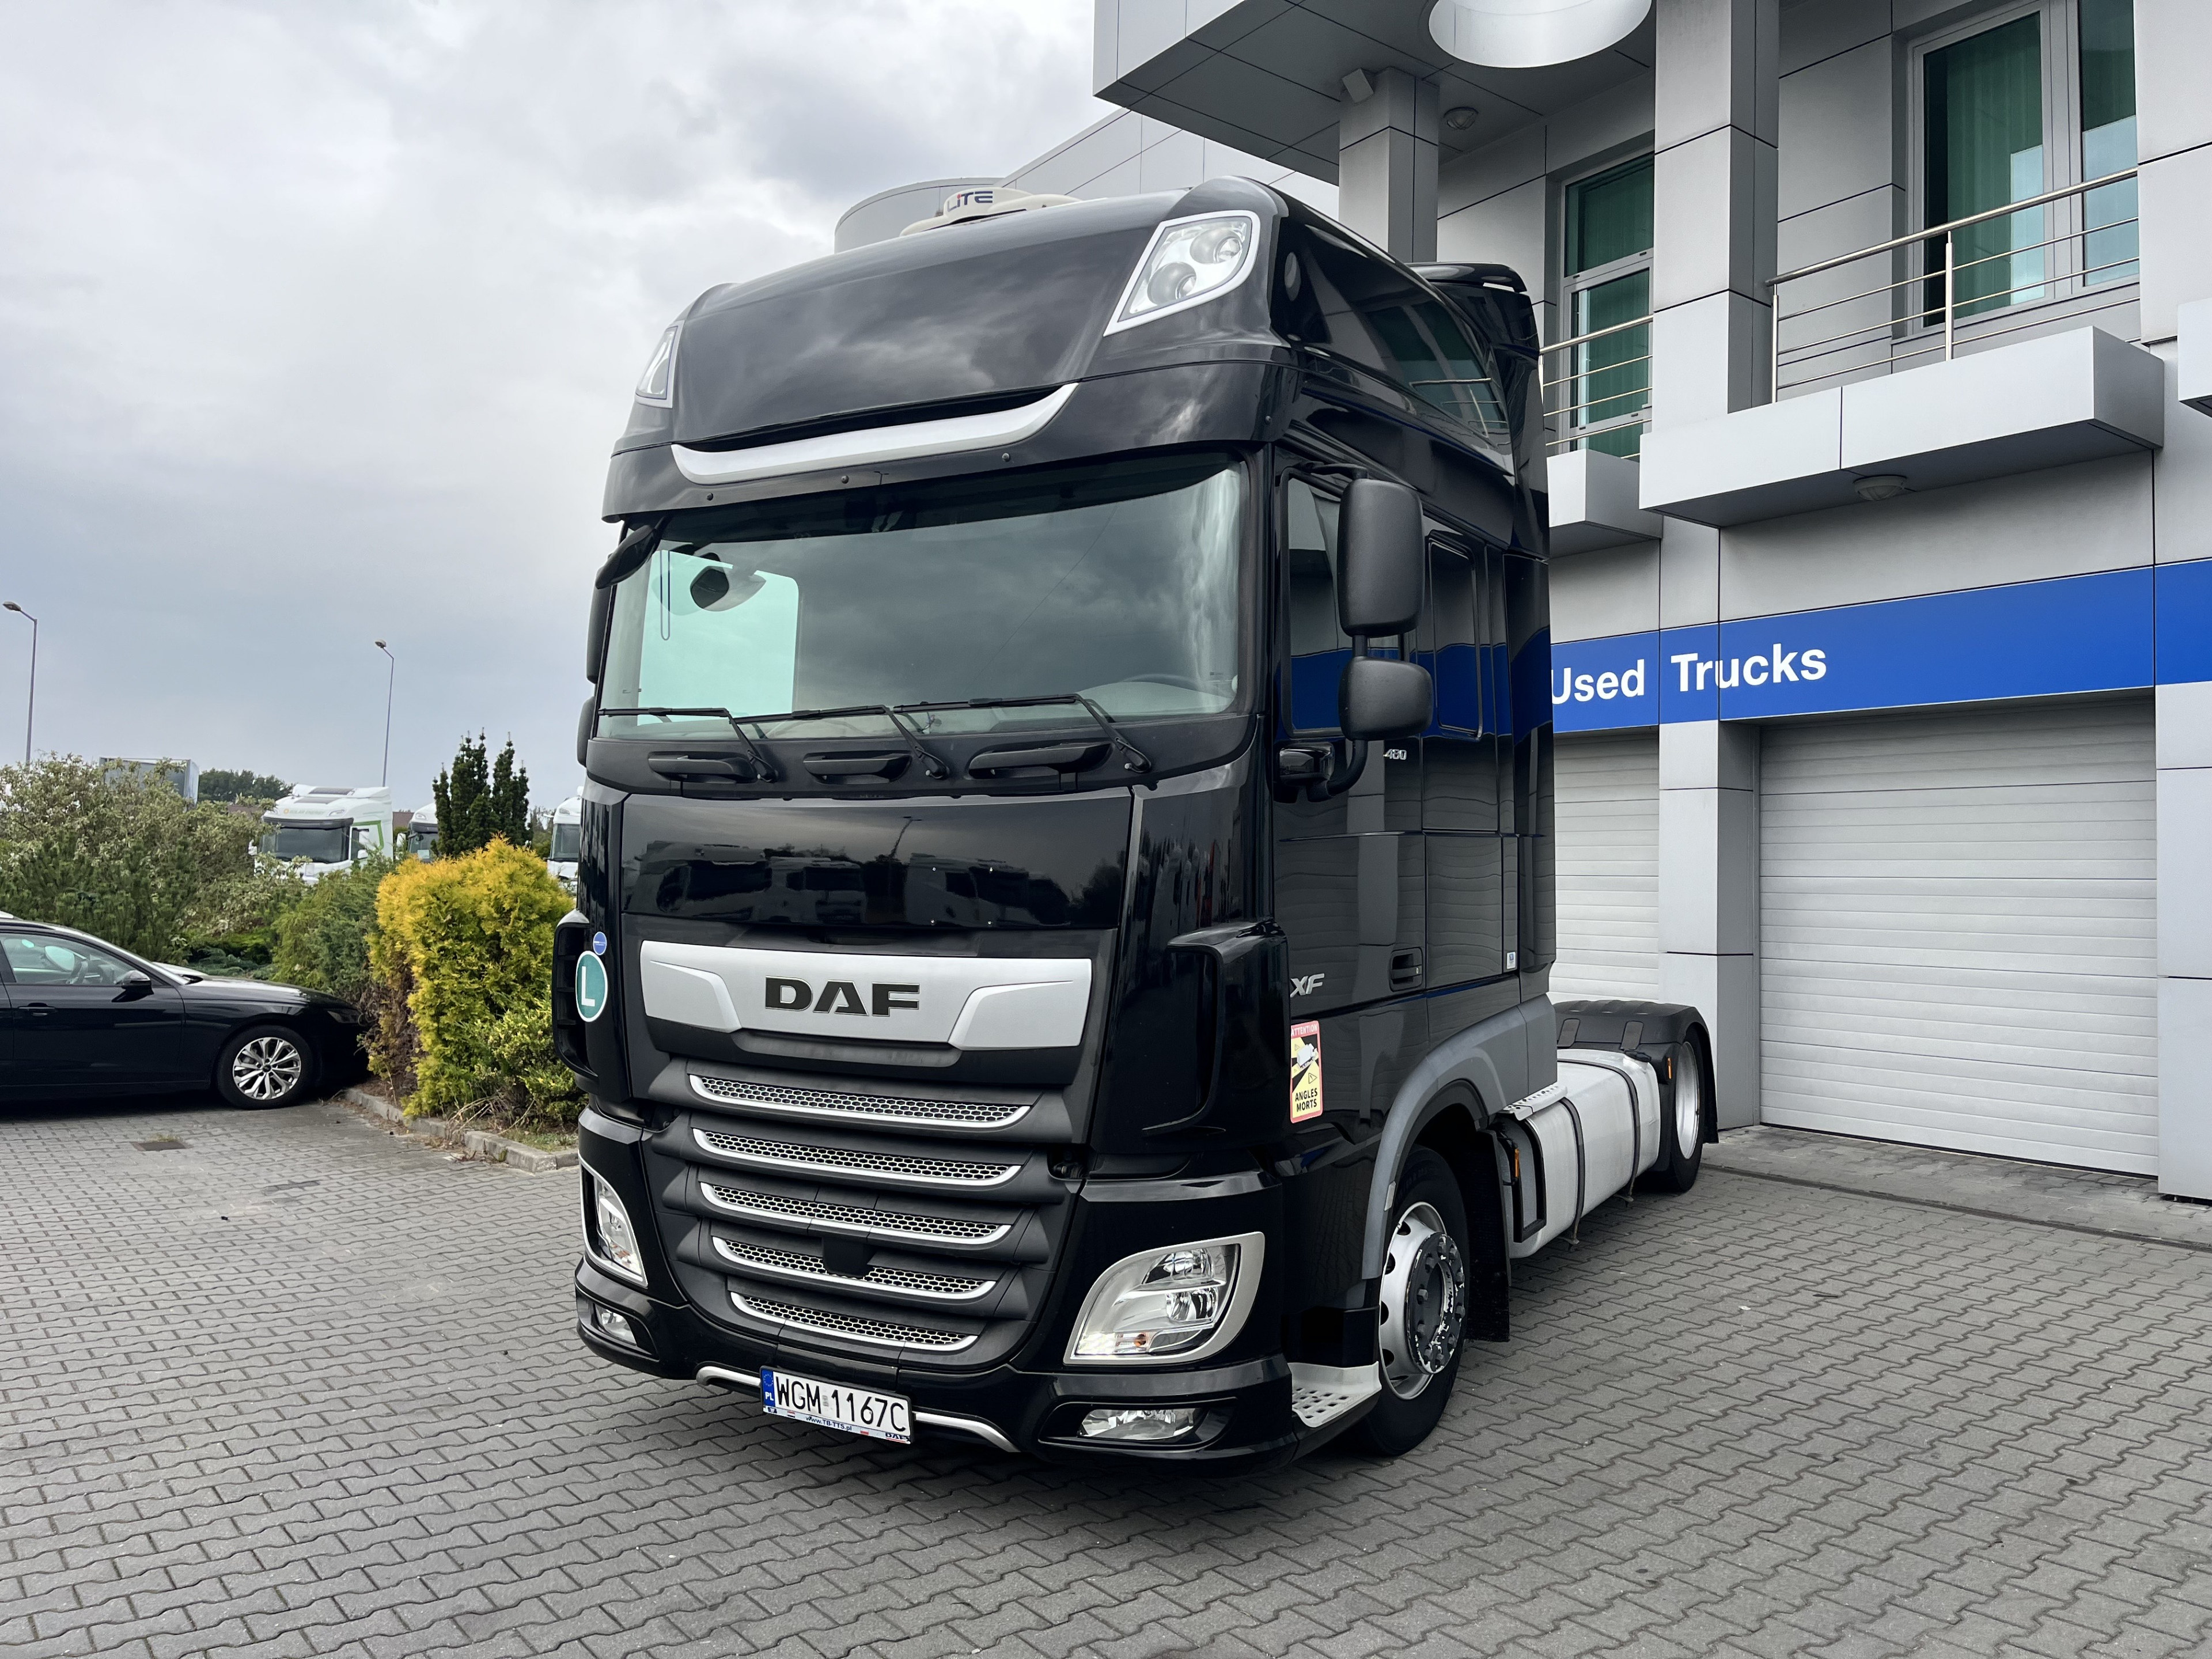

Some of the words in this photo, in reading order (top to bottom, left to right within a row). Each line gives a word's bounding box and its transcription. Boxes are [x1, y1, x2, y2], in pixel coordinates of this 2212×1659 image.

[1551, 660, 1645, 704] Used
[1671, 643, 1827, 692] Trucks
[581, 966, 596, 1007] L
[765, 975, 920, 1017] DAF
[1290, 973, 1325, 998] XF
[1291, 1024, 1317, 1036] ATTENTION
[1295, 1088, 1318, 1101] ANGLES
[1296, 1099, 1317, 1112] MORTS
[765, 1392, 774, 1401] PL
[775, 1376, 821, 1414] WGM
[831, 1389, 906, 1432] 1167C
